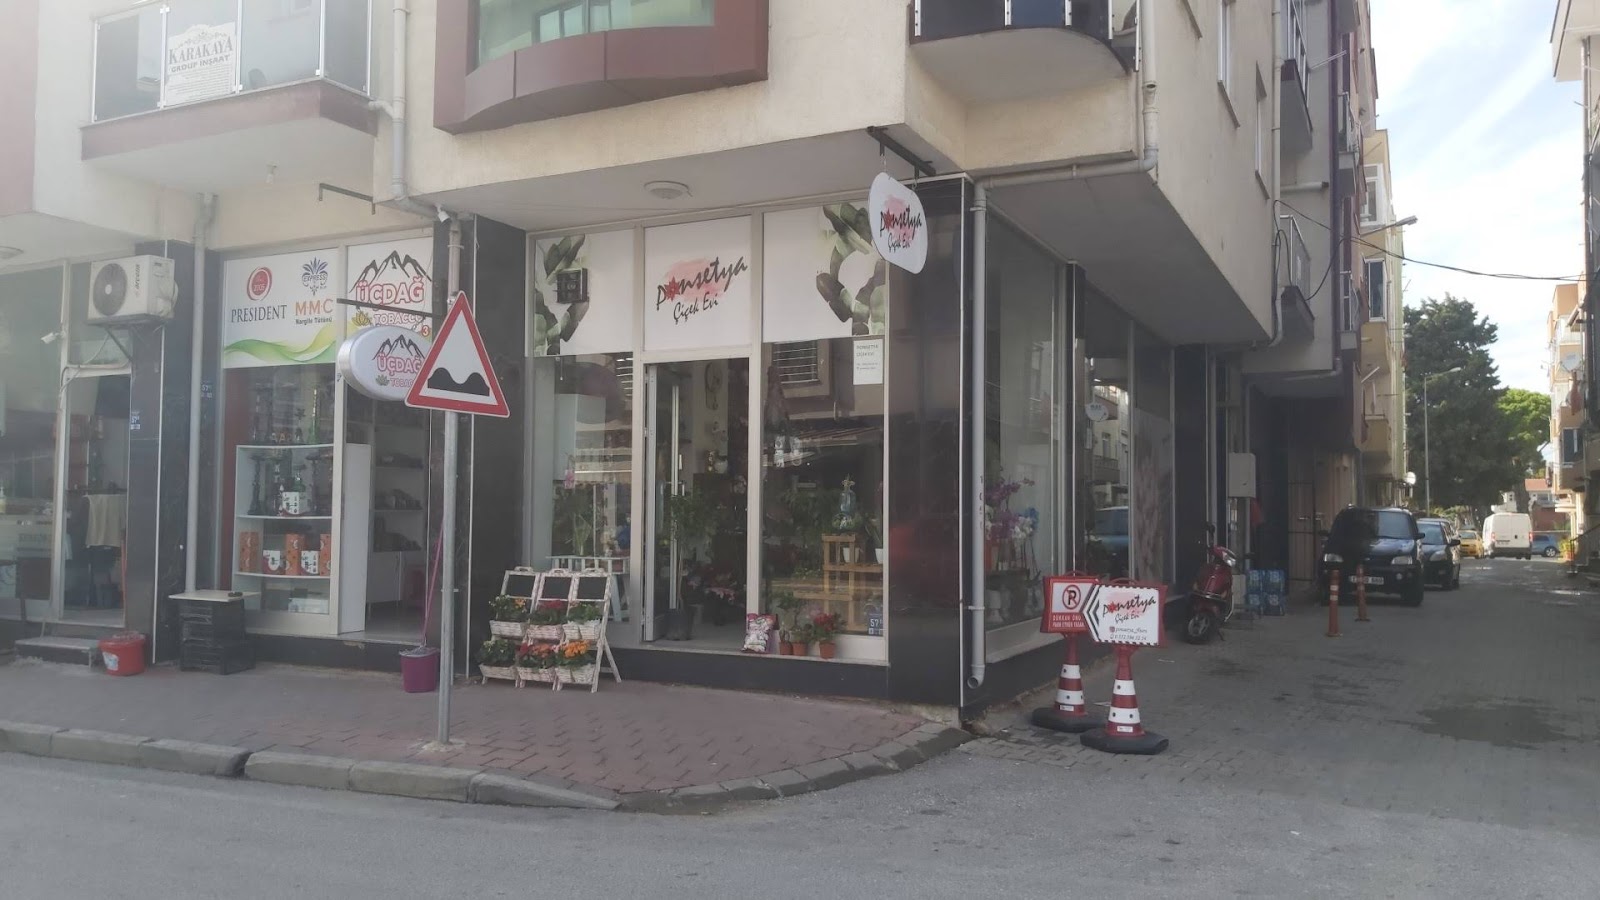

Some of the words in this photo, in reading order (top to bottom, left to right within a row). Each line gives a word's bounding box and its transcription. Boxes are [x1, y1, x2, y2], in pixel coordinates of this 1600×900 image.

[169, 36, 233, 64] KARAKAYA
[171, 62, 198, 73] GROUP
[231, 304, 287, 323] PRESIDENT
[673, 297, 700, 325] Çiçek
[702, 291, 719, 311] Evi
